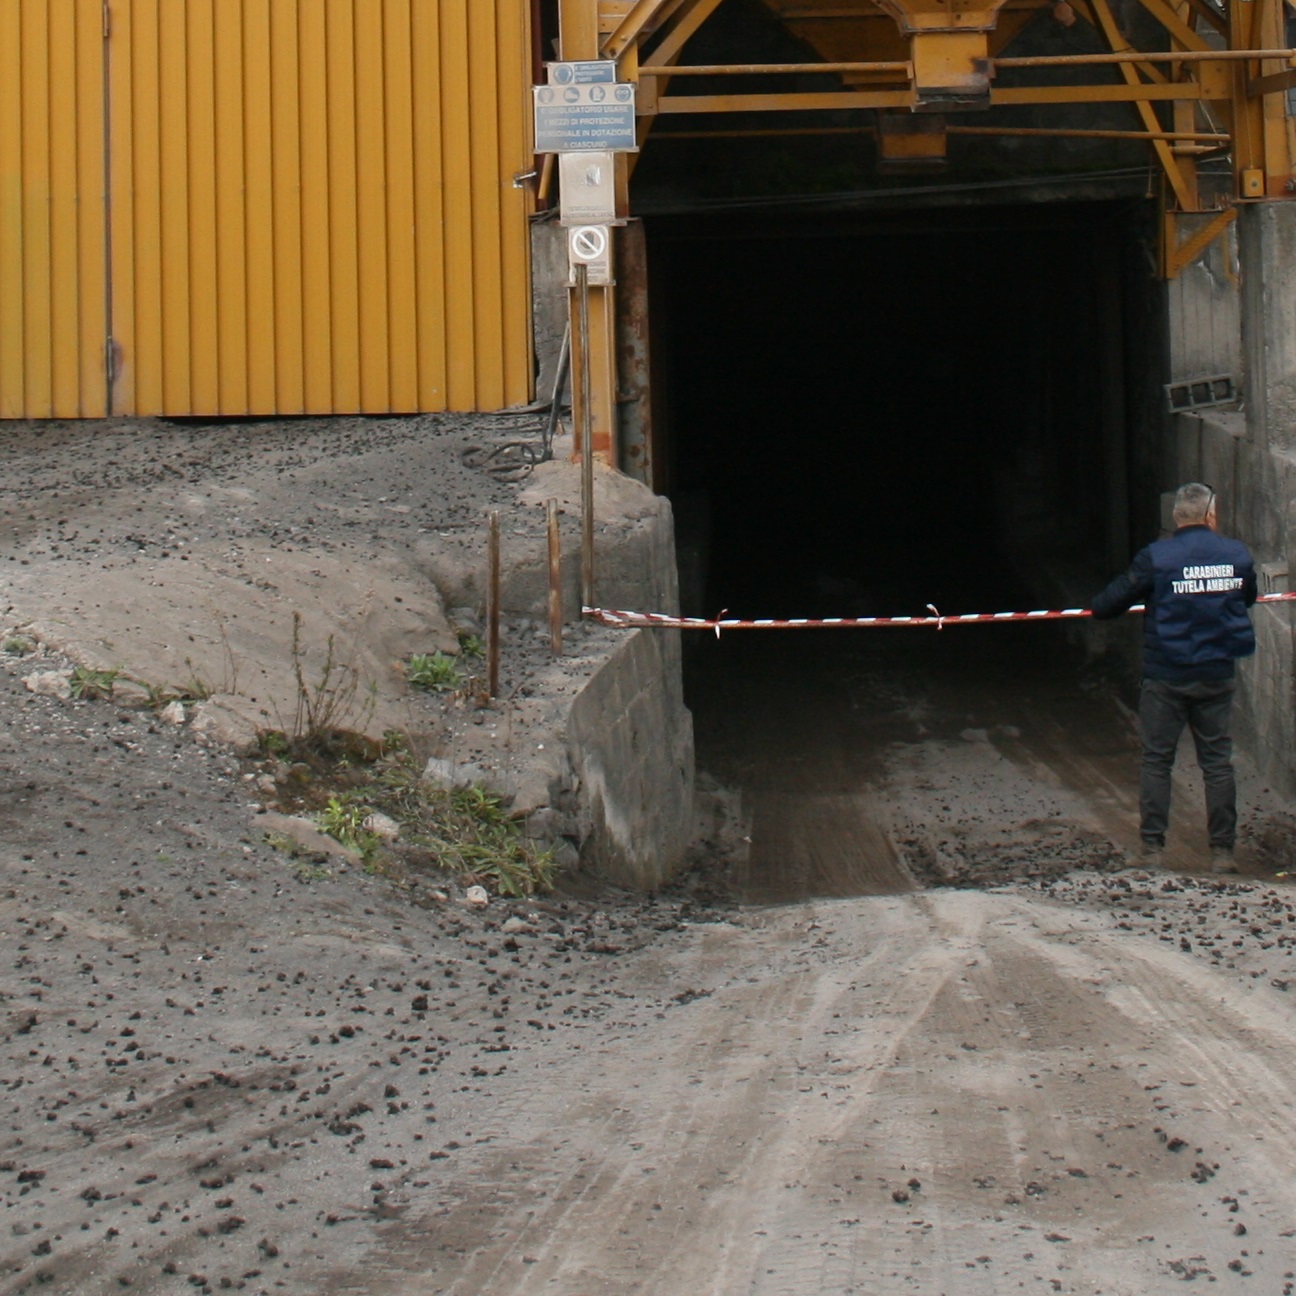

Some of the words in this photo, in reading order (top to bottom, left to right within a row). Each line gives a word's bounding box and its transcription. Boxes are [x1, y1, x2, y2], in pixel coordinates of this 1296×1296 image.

[604, 105, 629, 113] USARE
[571, 118, 578, 126] DI
[580, 117, 625, 125] PROTEZIONE
[591, 128, 633, 136] DOTAZIONE
[570, 141, 608, 149] CIASCUNO
[1183, 565, 1233, 579] CARABINIERI
[1172, 580, 1205, 594] TUTELA
[1206, 578, 1242, 592] AMBIENTE
